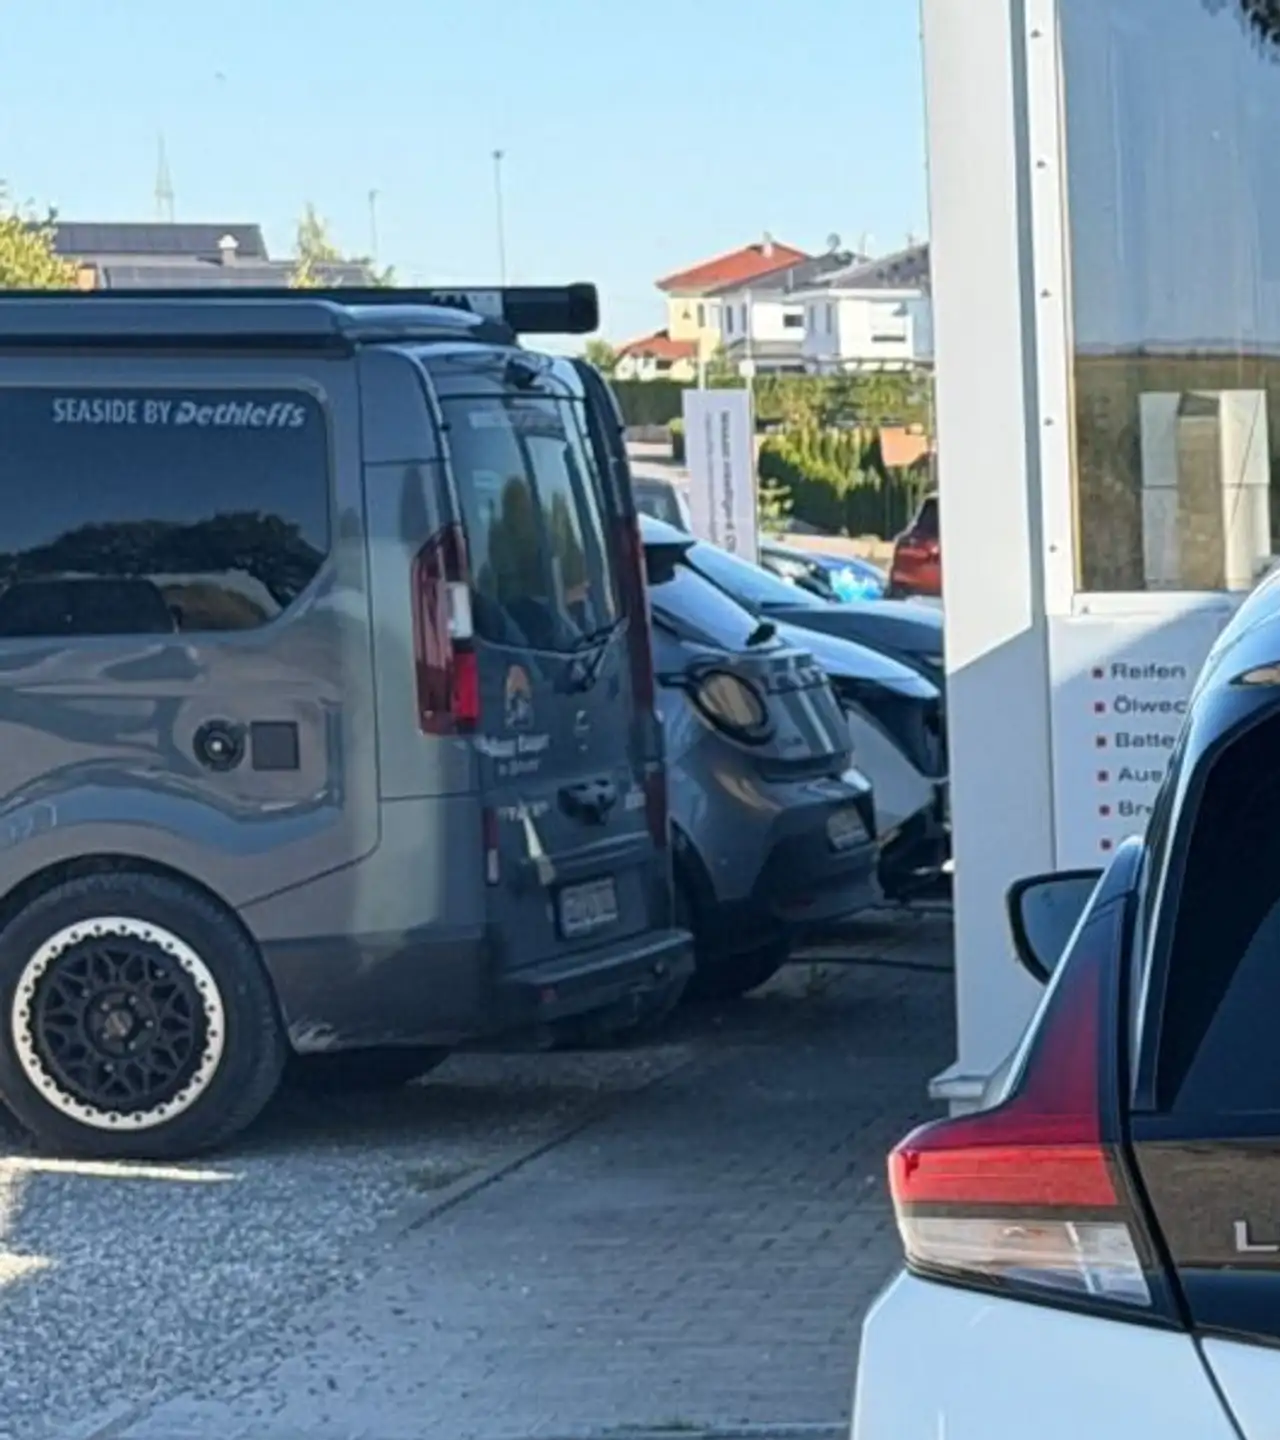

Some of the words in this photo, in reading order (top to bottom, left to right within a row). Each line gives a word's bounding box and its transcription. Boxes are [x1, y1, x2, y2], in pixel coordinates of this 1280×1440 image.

[53, 399, 137, 423] SEASIDE
[144, 400, 171, 424] BY
[174, 401, 306, 427] Dethleffs
[1110, 663, 1186, 680] Reifen
[1115, 731, 1175, 749] Batte
